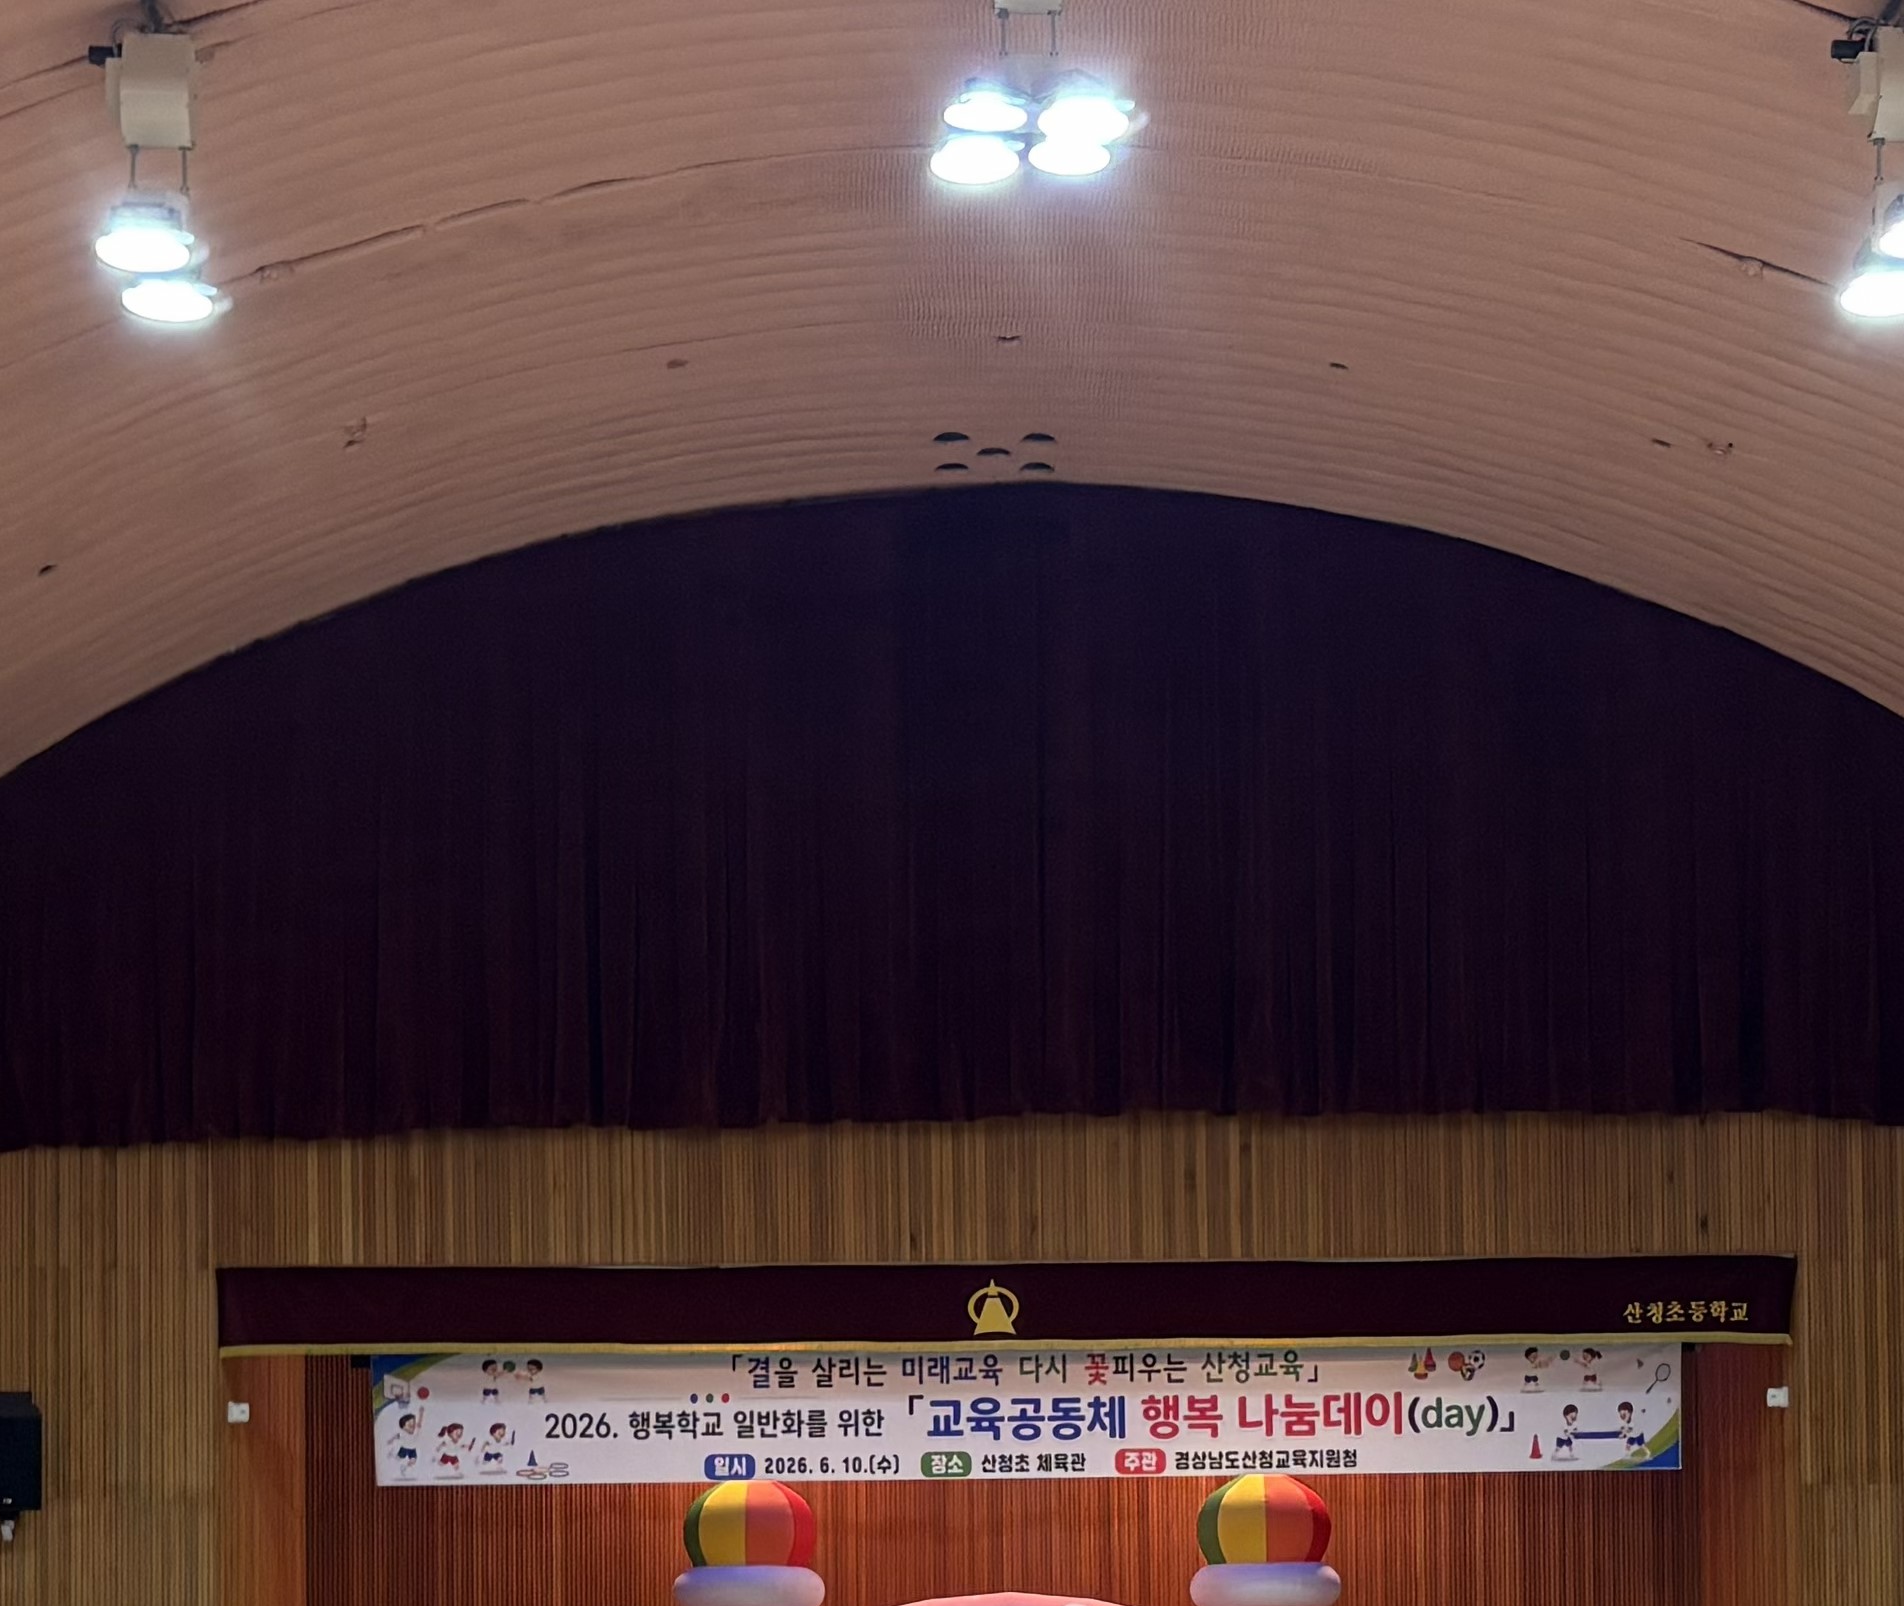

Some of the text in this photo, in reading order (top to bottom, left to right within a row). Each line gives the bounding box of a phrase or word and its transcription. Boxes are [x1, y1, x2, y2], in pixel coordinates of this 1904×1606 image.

[811, 1356, 888, 1389] 살리는
[901, 1353, 1004, 1387] 미래교육
[1018, 1353, 1068, 1384] 다시
[1084, 1352, 1188, 1387] 꽃피우는
[544, 1412, 619, 1440] 2026.
[628, 1410, 724, 1441] 행복학교
[733, 1409, 828, 1440] 일반화를
[837, 1408, 885, 1439] 위한
[1141, 1393, 1224, 1440] 행복
[713, 1456, 747, 1477] 일시
[764, 1456, 813, 1475] 2026.
[819, 1456, 835, 1474] 6.
[930, 1452, 1086, 1475] 장소 산청초 체육관
[1124, 1449, 1358, 1472] 주관 경상남도산청교육지원청
